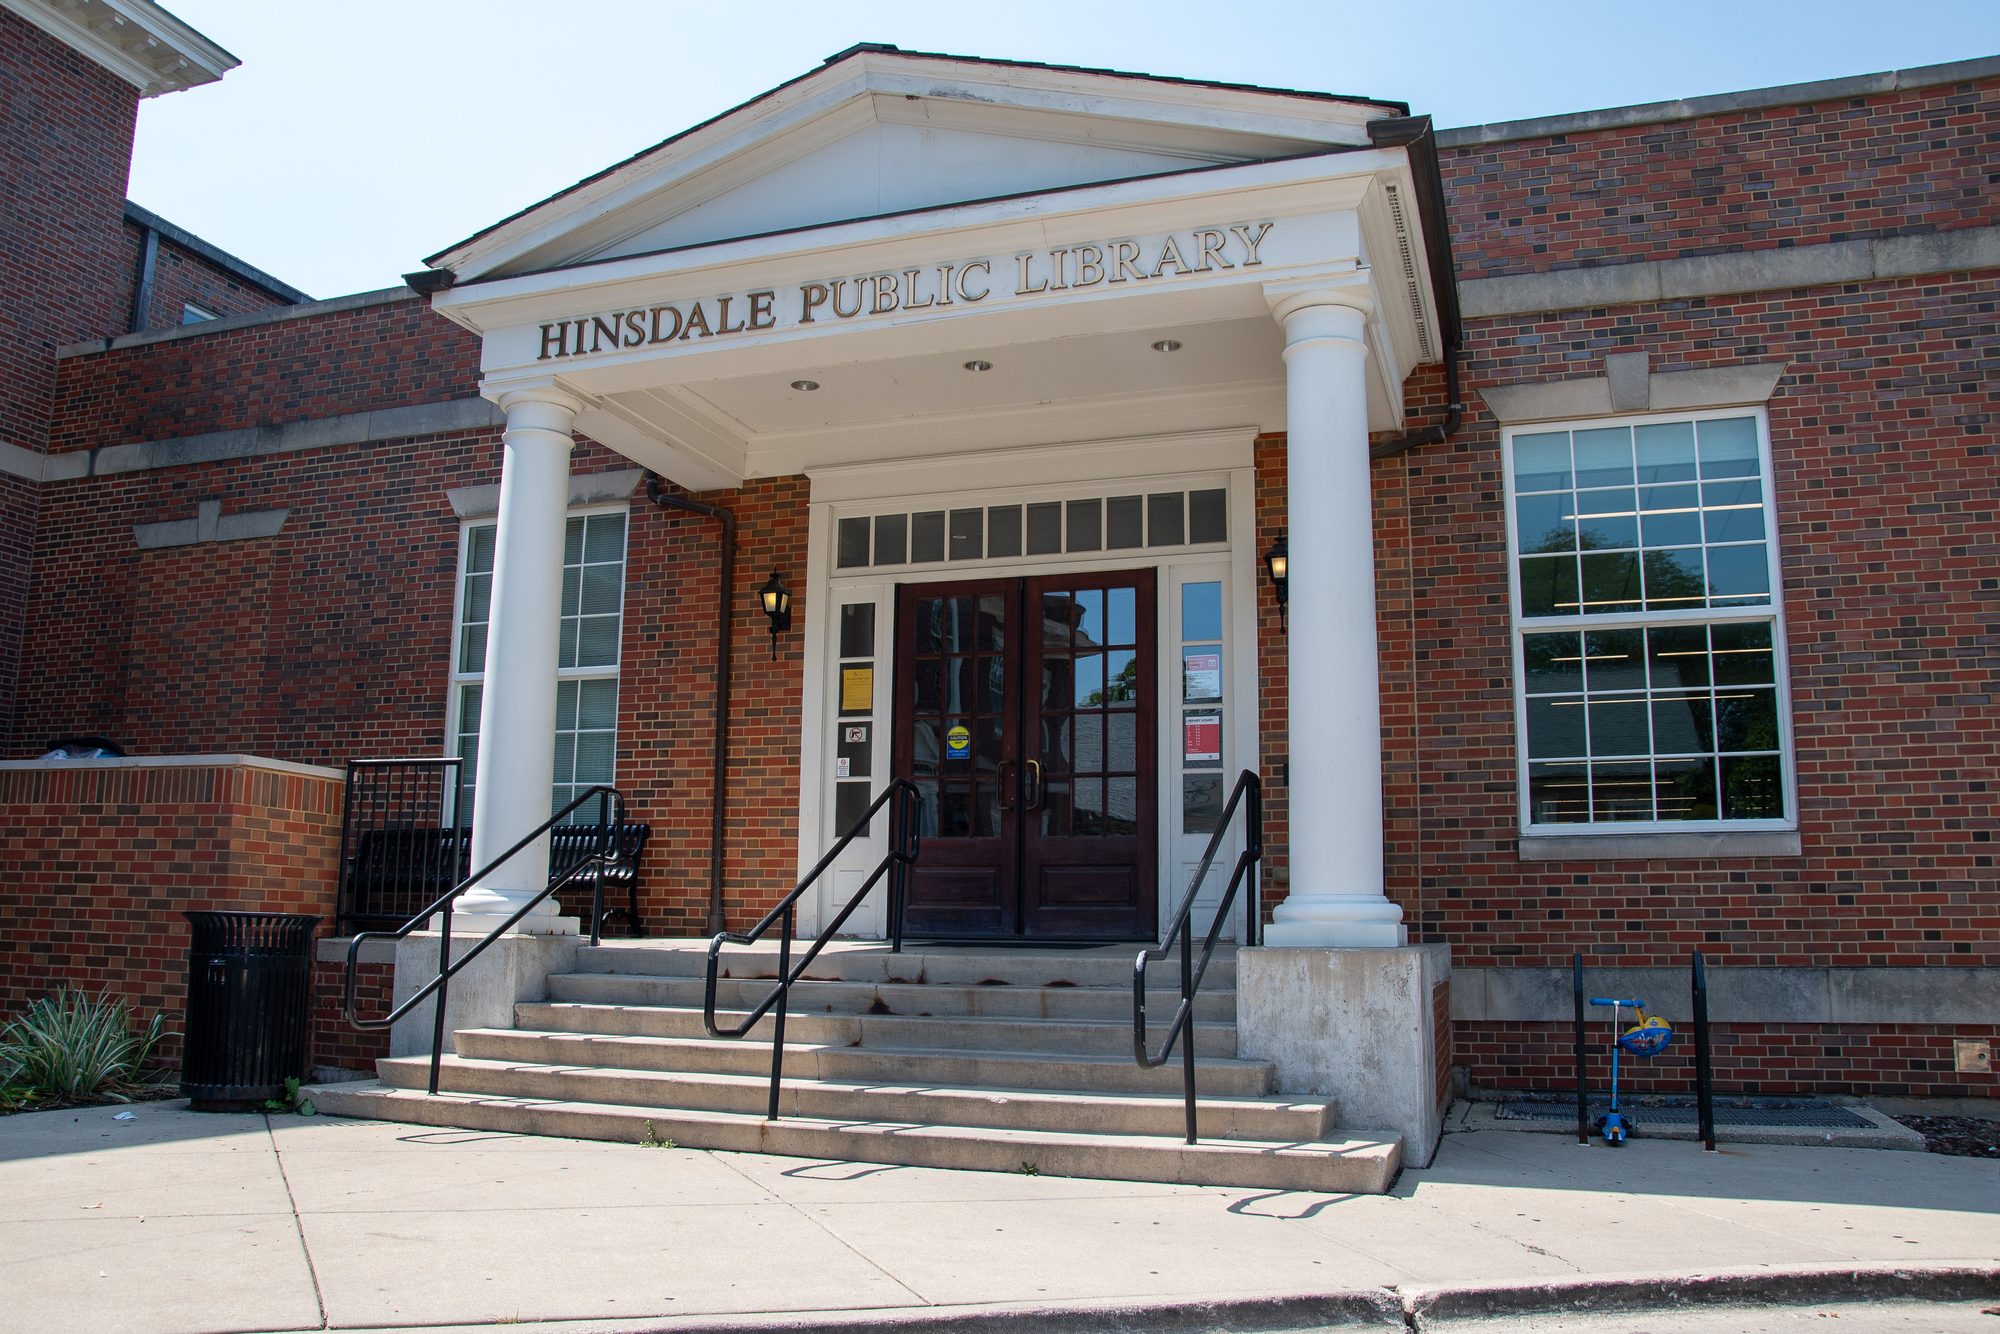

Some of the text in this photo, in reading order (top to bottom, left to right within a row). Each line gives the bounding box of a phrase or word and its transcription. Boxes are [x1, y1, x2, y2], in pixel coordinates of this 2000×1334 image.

[537, 223, 1274, 360] HINSDALE PUBLIC LIBRARY
